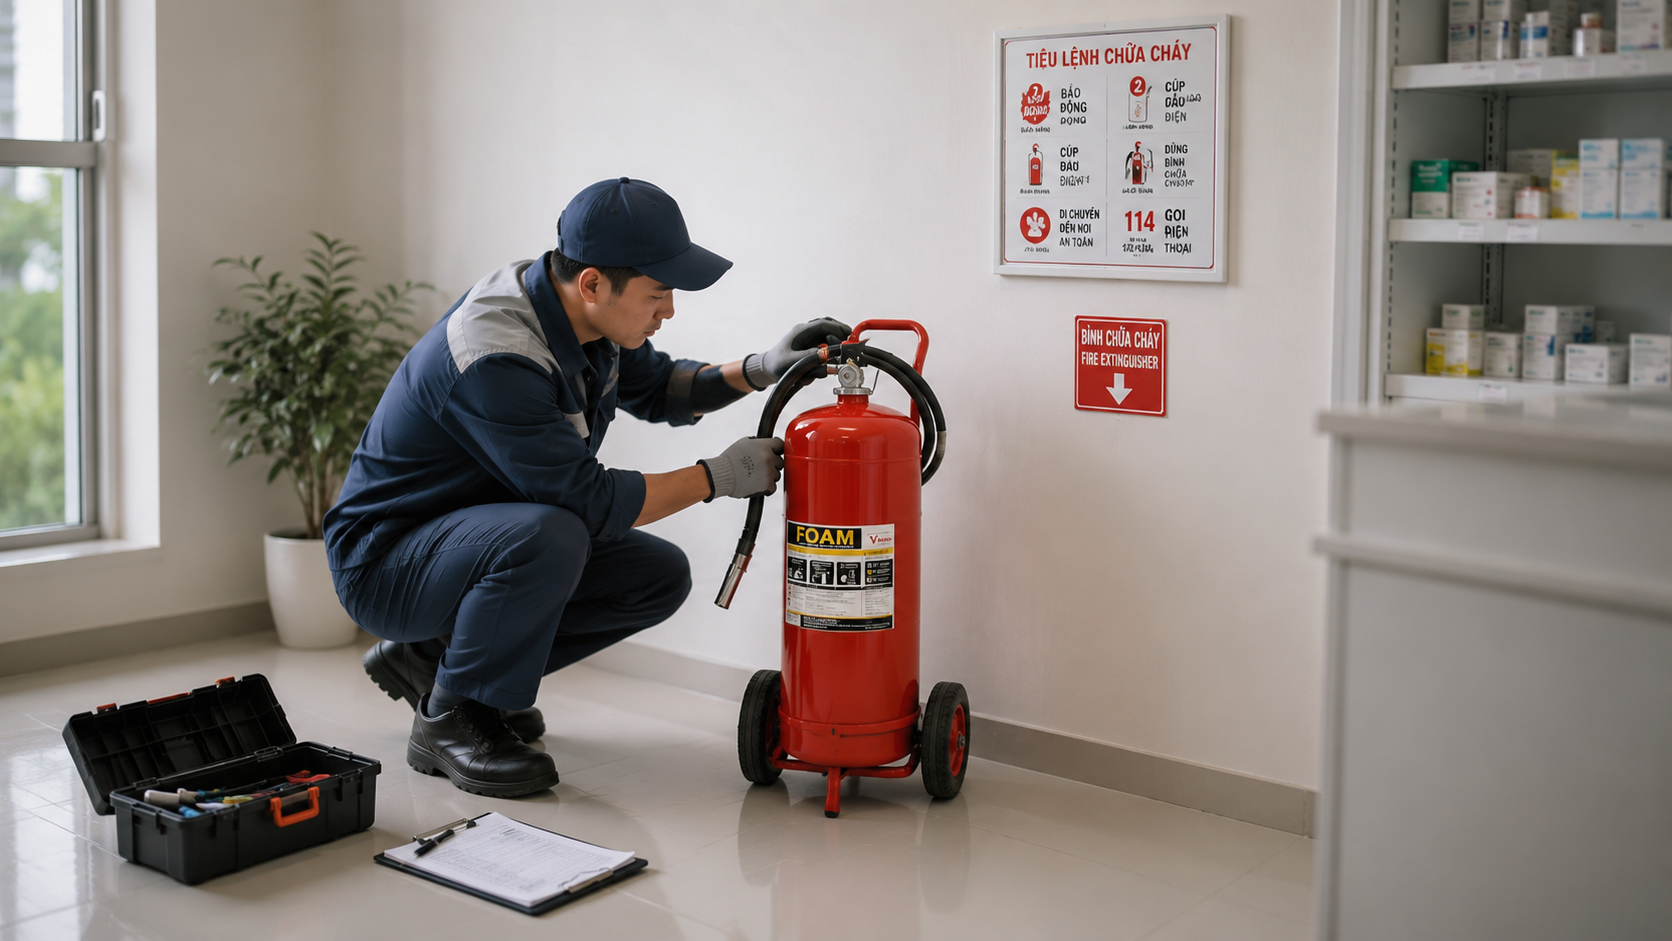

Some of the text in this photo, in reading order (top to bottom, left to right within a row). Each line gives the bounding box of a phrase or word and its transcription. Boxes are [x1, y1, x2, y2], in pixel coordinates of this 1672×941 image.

[1026, 47, 1057, 70] TIỆU
[1062, 46, 1099, 70] LỆNH
[1150, 39, 1192, 62] CHÁY
[1134, 79, 1142, 93] 2
[1124, 210, 1156, 232] 114
[1081, 324, 1103, 346] BÌNH
[1134, 327, 1160, 349] CHÁY
[1081, 351, 1159, 370] FIRE EXTINGUISHER
[796, 525, 854, 546] FOAM
